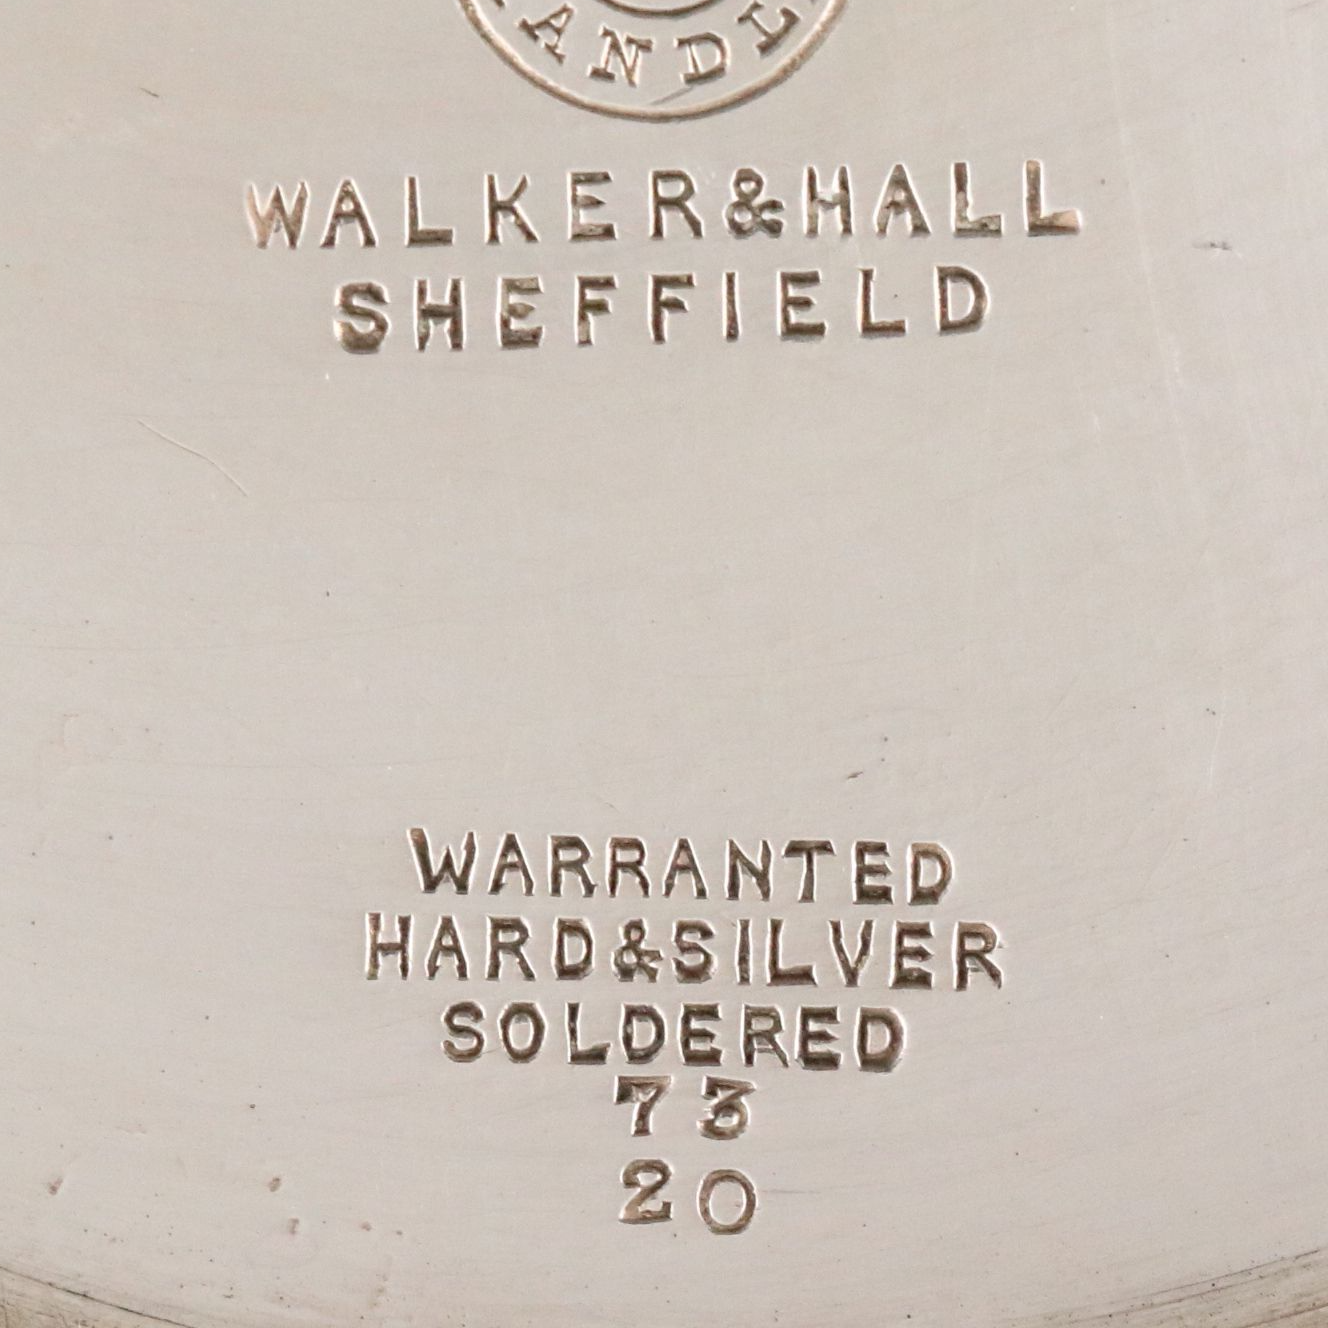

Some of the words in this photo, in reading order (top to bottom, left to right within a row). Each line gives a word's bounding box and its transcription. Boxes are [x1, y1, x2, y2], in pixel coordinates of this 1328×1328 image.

[247, 160, 1082, 249] WALKER&HALL
[333, 265, 991, 354] SHEFFIELD
[408, 827, 953, 905] WARRANTED
[366, 911, 1004, 990] HARD&SILVER
[441, 1001, 906, 1072] SOLDERED
